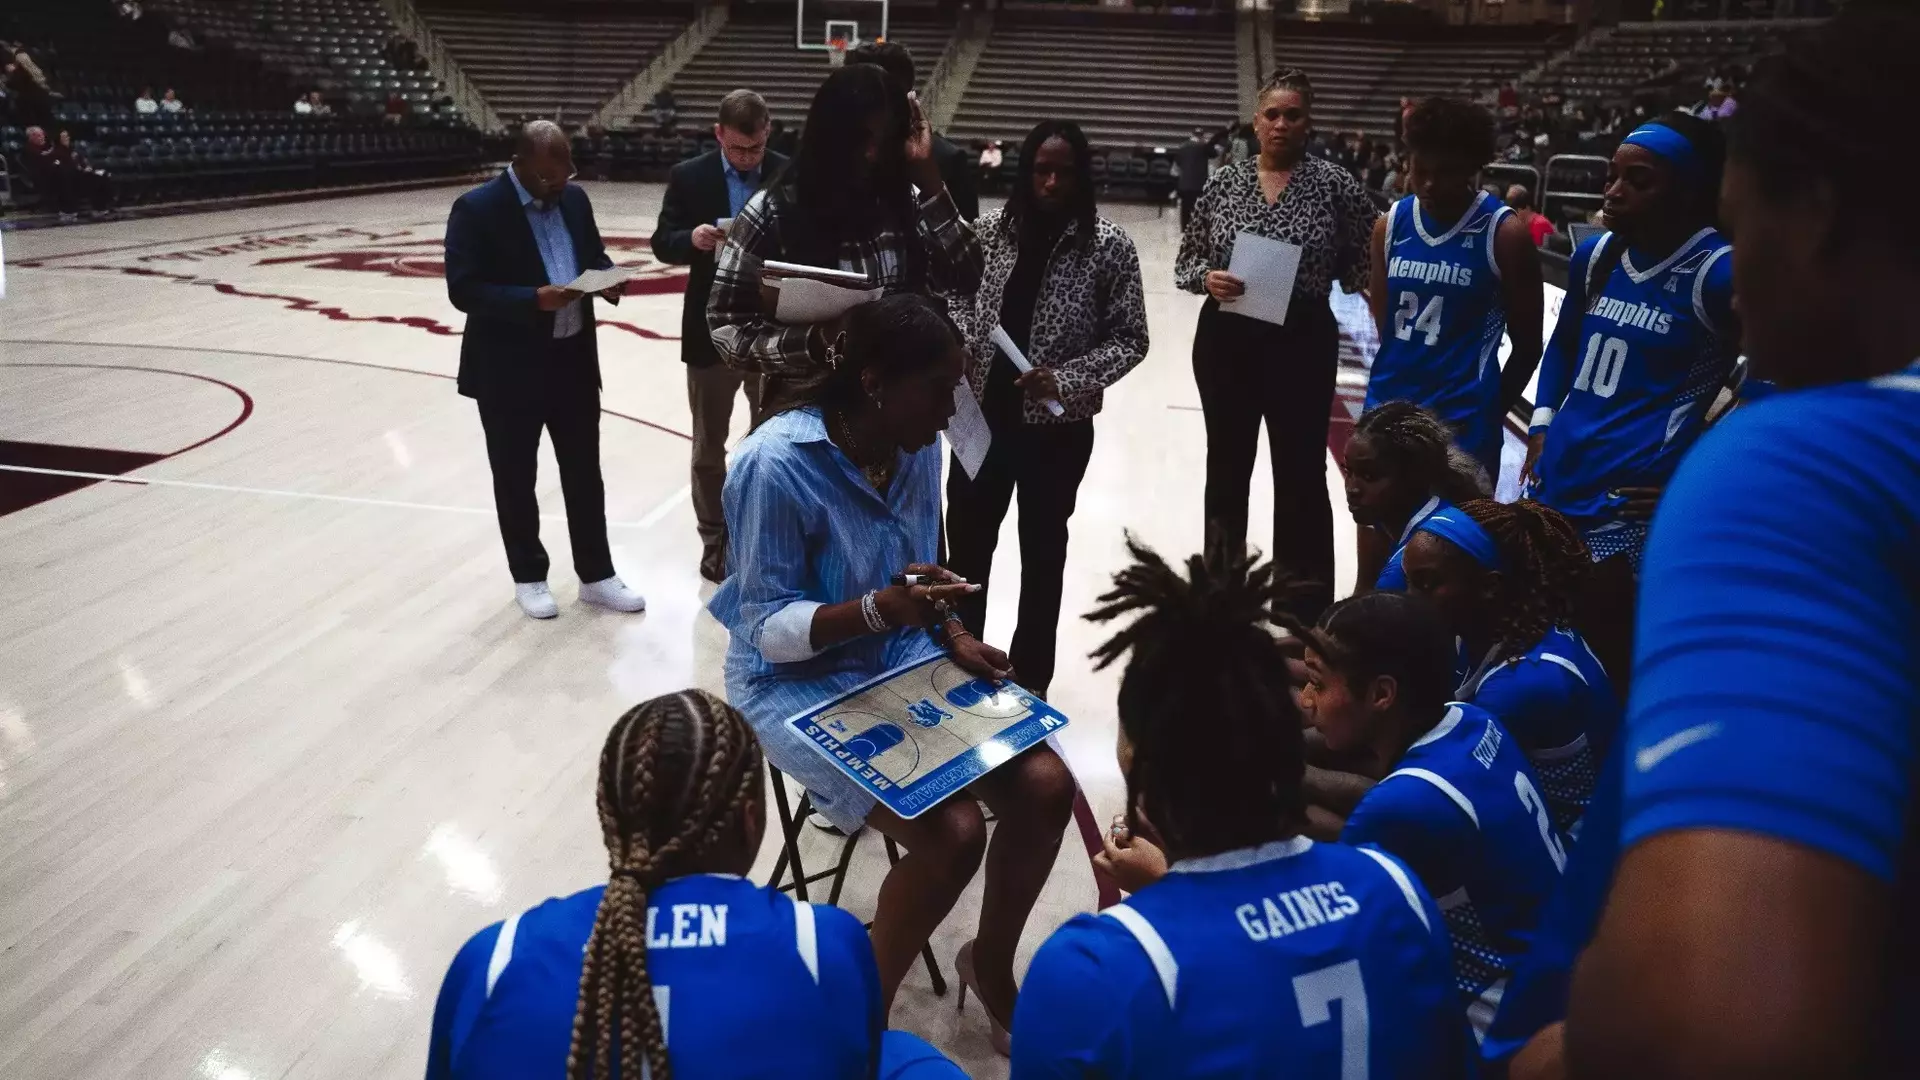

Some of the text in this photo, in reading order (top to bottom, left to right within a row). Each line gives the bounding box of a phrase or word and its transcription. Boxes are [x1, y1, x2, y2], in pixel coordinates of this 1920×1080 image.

[1388, 256, 1472, 286] Memphis
[1395, 291, 1444, 346] 24
[1573, 332, 1629, 398] 10
[805, 725, 893, 791] MEMPHIS
[1514, 770, 1568, 877] 2
[645, 904, 728, 949] LEN
[1235, 881, 1360, 942] GAINES
[1292, 959, 1369, 1080] 7
